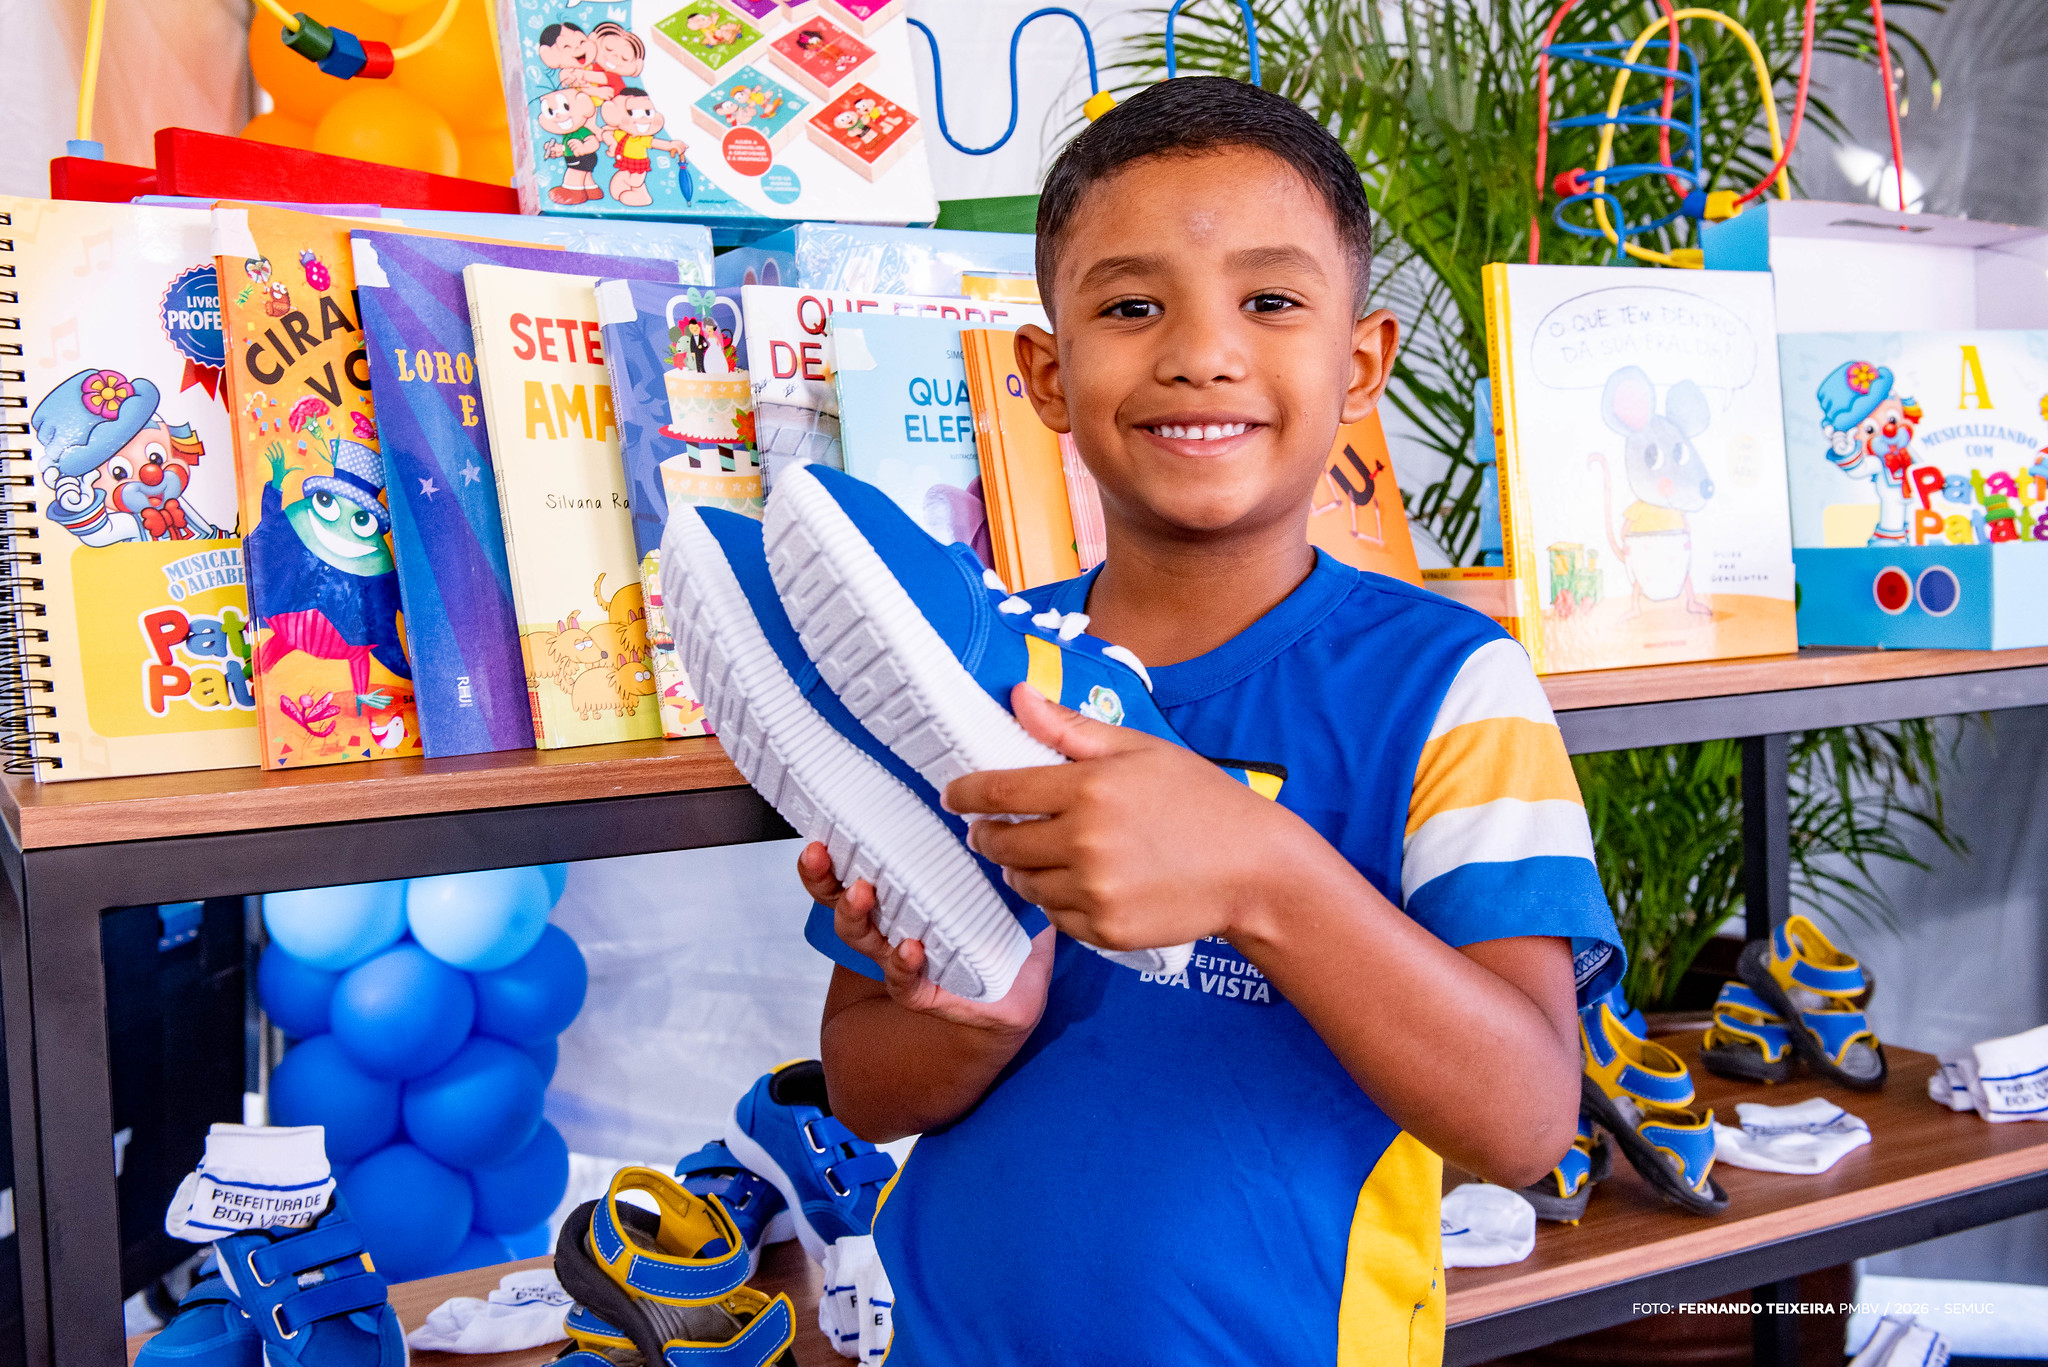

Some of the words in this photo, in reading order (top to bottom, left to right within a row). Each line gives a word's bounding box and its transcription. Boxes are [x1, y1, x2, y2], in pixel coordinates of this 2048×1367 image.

[187, 296, 220, 309] LIVRO
[167, 310, 223, 330] PROFE
[1549, 321, 1566, 338] O
[1572, 307, 1611, 333] QUE
[509, 312, 605, 366] SETE
[1560, 340, 1593, 364] DA
[394, 348, 478, 385] LORO
[769, 340, 826, 380] DE
[1958, 345, 1994, 409] A
[908, 378, 970, 407] QUA
[458, 394, 479, 427] E
[524, 380, 620, 442] AMA
[904, 415, 977, 442] ELEF
[1921, 424, 2038, 449] MUSICALIZANDO
[1965, 444, 1994, 459] COM
[545, 493, 603, 509] Silvana
[612, 492, 630, 509] Ra
[170, 584, 185, 600] O
[144, 609, 251, 667] Pat
[149, 659, 255, 714] Pat
[1189, 952, 1264, 979] EITUR
[1200, 971, 1270, 1004] VISTA
[212, 1188, 303, 1212] PREFEITURA
[304, 1193, 321, 1209] DE
[212, 1205, 254, 1226] BOA
[260, 1211, 313, 1228] VISTA
